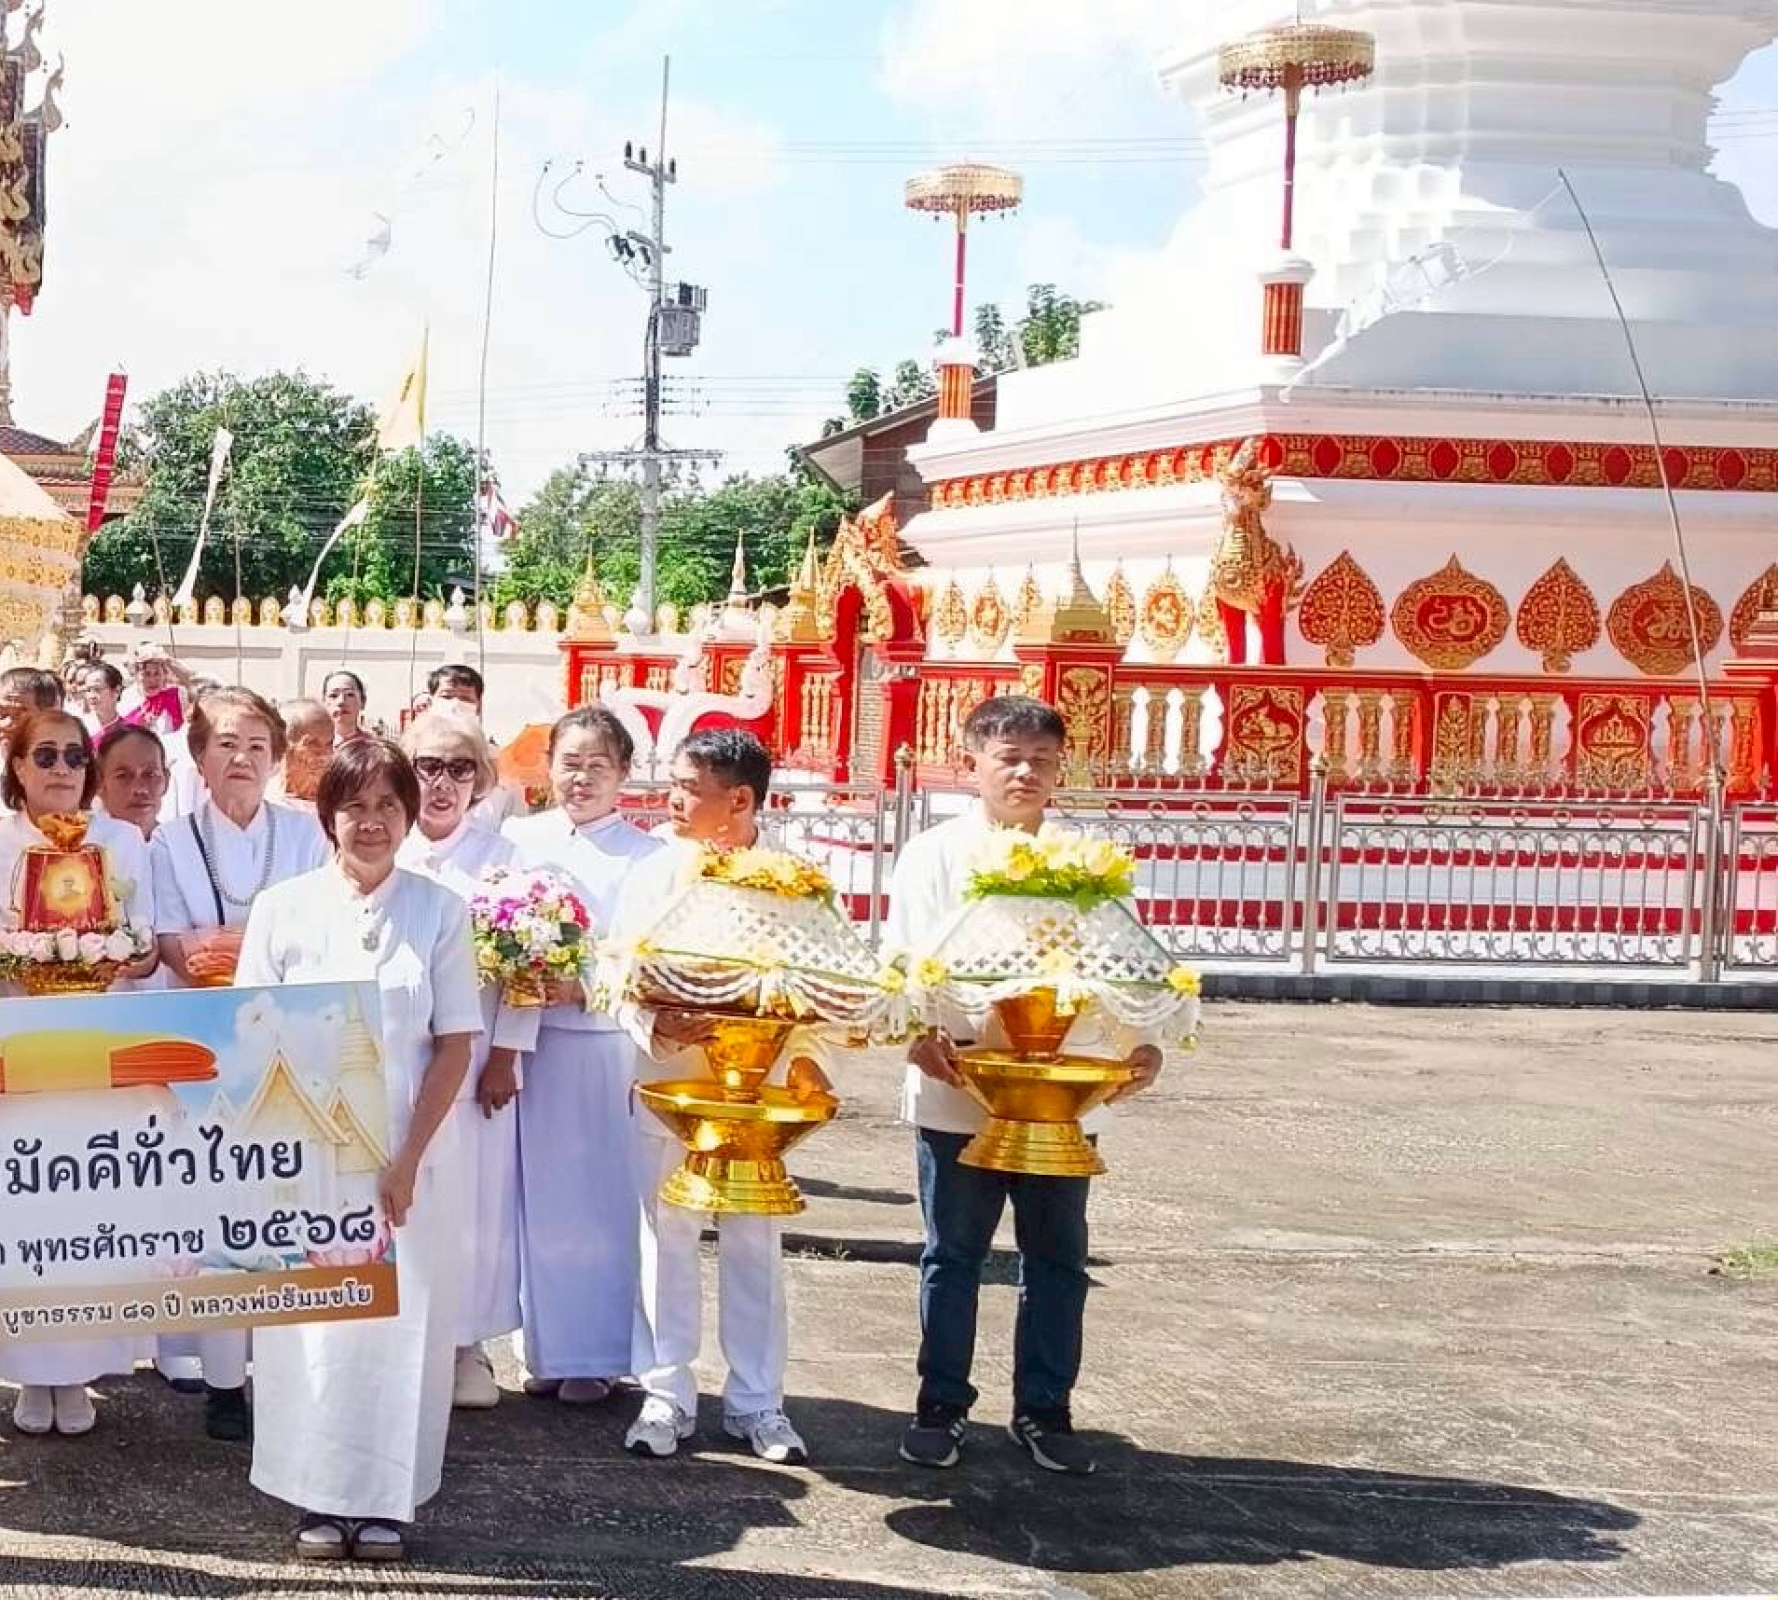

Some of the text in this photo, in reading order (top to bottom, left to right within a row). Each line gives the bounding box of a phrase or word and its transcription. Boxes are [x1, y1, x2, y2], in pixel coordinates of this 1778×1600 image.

[18, 1222, 204, 1277] พุทธศักราช
[219, 1205, 377, 1250] ๒๕๖๘
[4, 1304, 112, 1334] บูชาธรรม
[163, 1291, 182, 1317] ปี
[192, 1281, 371, 1315] หลวงพ่อธัมมชโย
